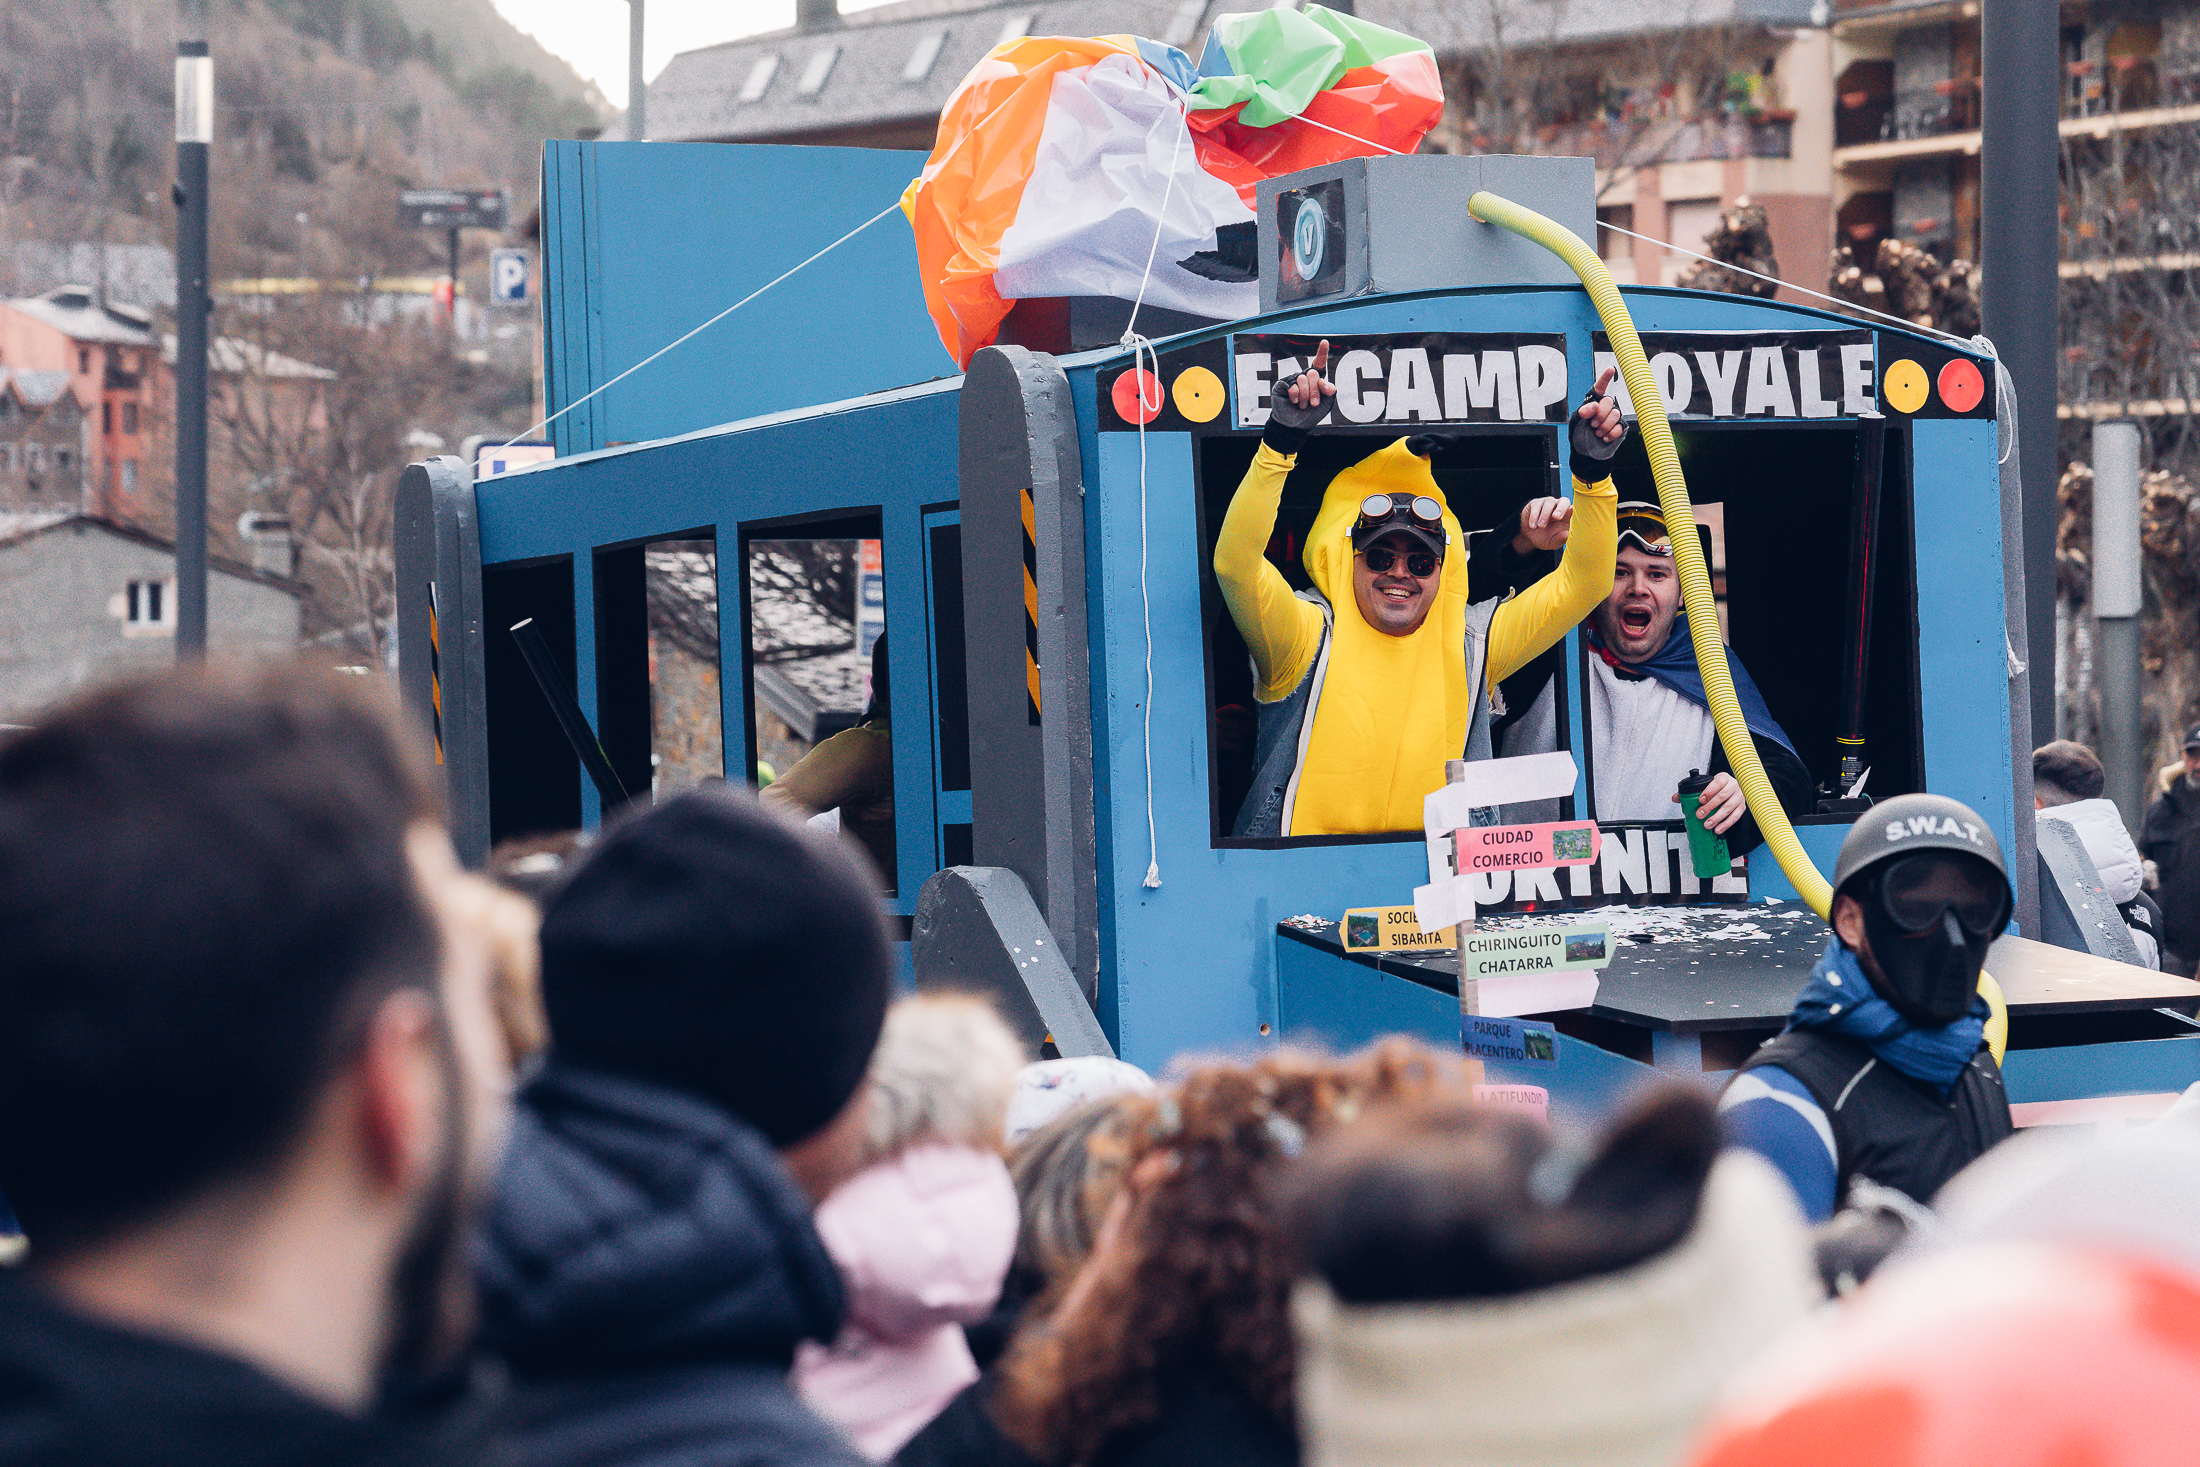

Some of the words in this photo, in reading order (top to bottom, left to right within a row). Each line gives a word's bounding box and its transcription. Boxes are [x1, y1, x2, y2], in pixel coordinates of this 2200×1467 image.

[498, 257, 523, 298] P
[1482, 830, 1534, 846] CIUDAD
[1885, 815, 1984, 847] S.W.A.T.
[1473, 851, 1544, 868] COMERCIO
[1391, 932, 1443, 946] SIBARITA
[1468, 933, 1562, 953] CHIRINGUITO
[1479, 956, 1554, 974] CHATARRA
[1474, 1022, 1512, 1038] PARQUE
[1464, 1042, 1524, 1060] PLACENTERO
